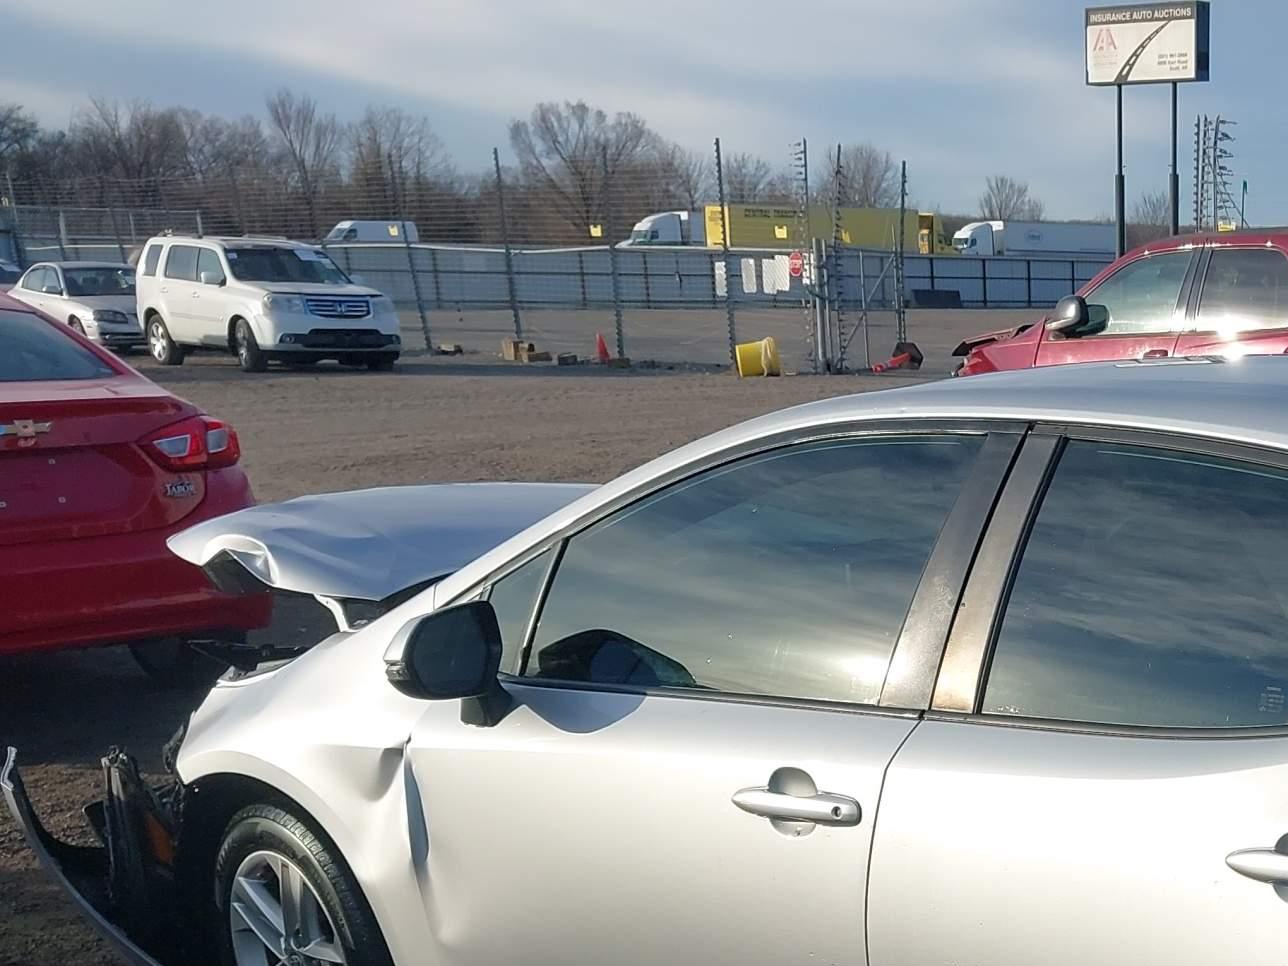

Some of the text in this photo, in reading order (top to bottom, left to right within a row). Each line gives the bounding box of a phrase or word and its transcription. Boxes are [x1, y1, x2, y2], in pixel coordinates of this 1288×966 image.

[1090, 7, 1192, 23] INSURANCE AUTO AUCTIONS
